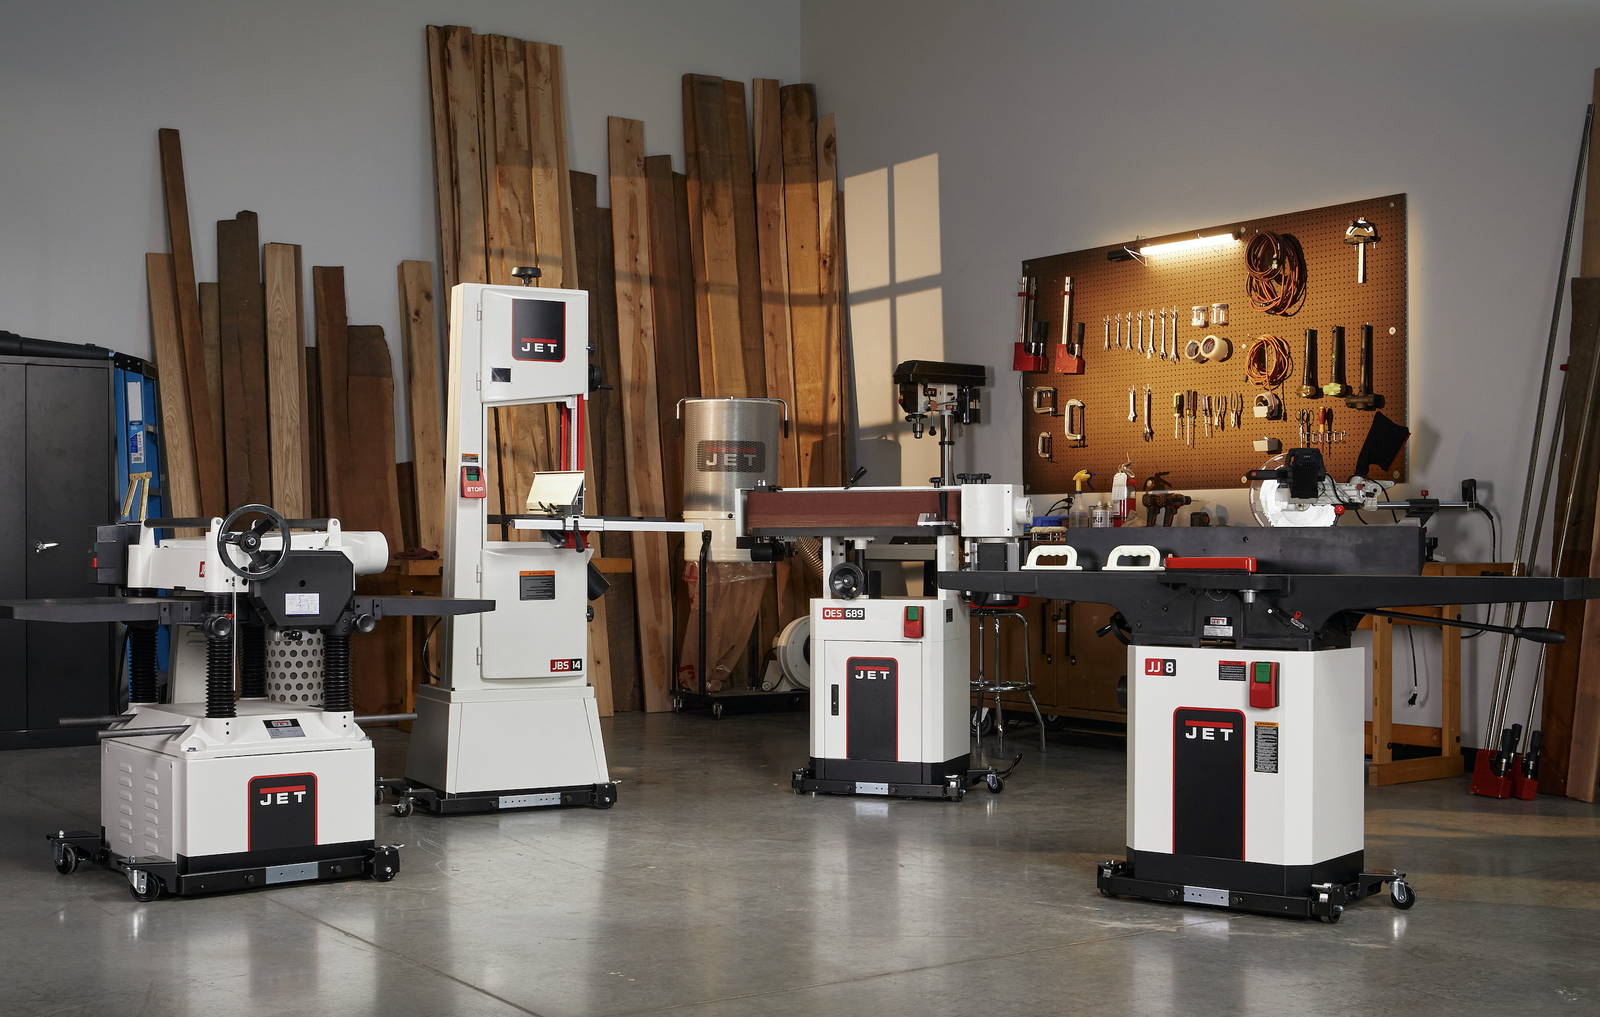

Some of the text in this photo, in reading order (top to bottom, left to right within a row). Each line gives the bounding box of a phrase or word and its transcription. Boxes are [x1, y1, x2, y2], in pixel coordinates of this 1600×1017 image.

[521, 342, 557, 353] JET
[706, 453, 756, 466] JET
[824, 609, 864, 618] OES 689
[552, 660, 581, 670] JBS 14
[1147, 661, 1174, 673] JJ 8
[855, 670, 890, 680] JET
[1185, 726, 1234, 741] JET
[259, 791, 307, 806] JET
